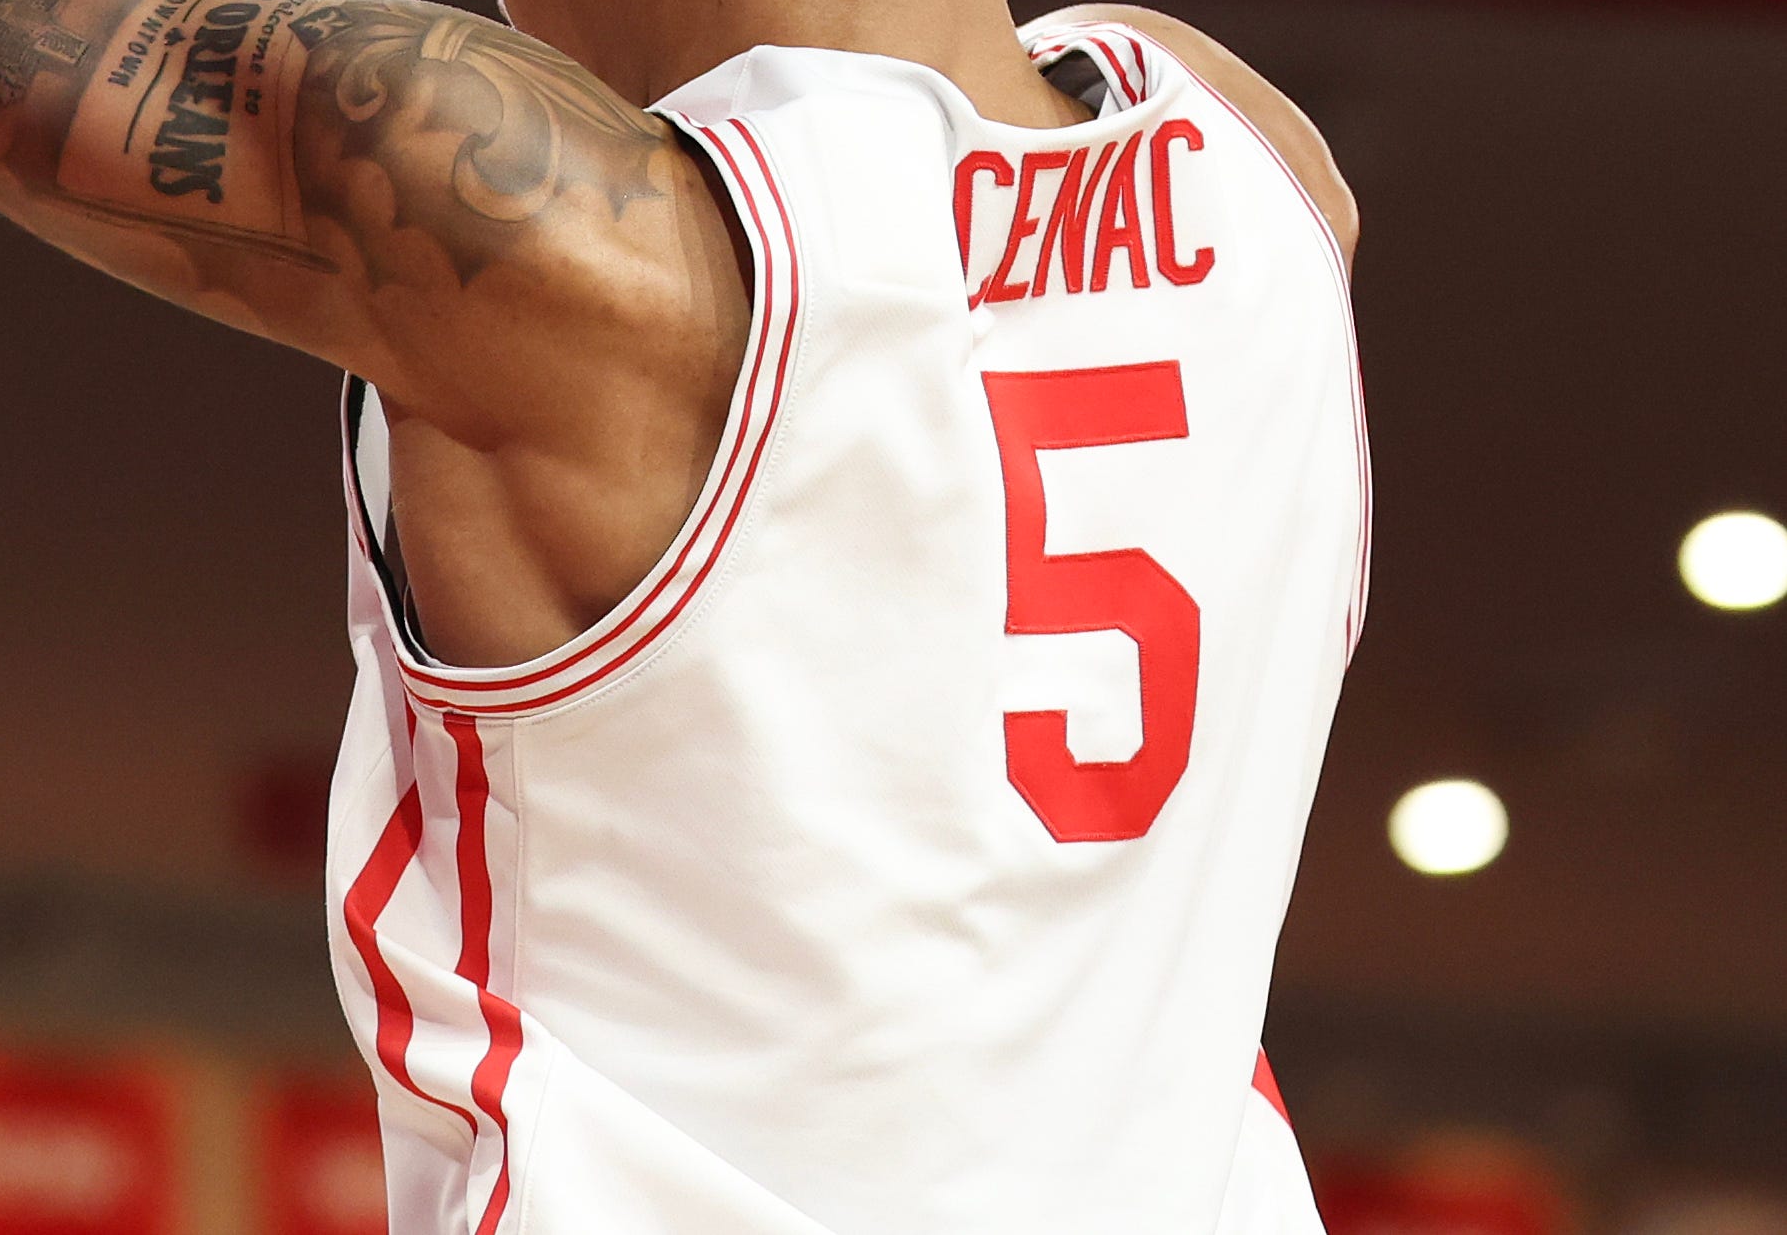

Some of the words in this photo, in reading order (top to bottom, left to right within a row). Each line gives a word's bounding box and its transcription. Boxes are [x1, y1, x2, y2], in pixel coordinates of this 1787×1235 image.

[149, 1, 262, 204] ORLEANS
[244, 89, 264, 115] to
[951, 119, 1215, 313] CENAC
[980, 360, 1201, 843] 5
